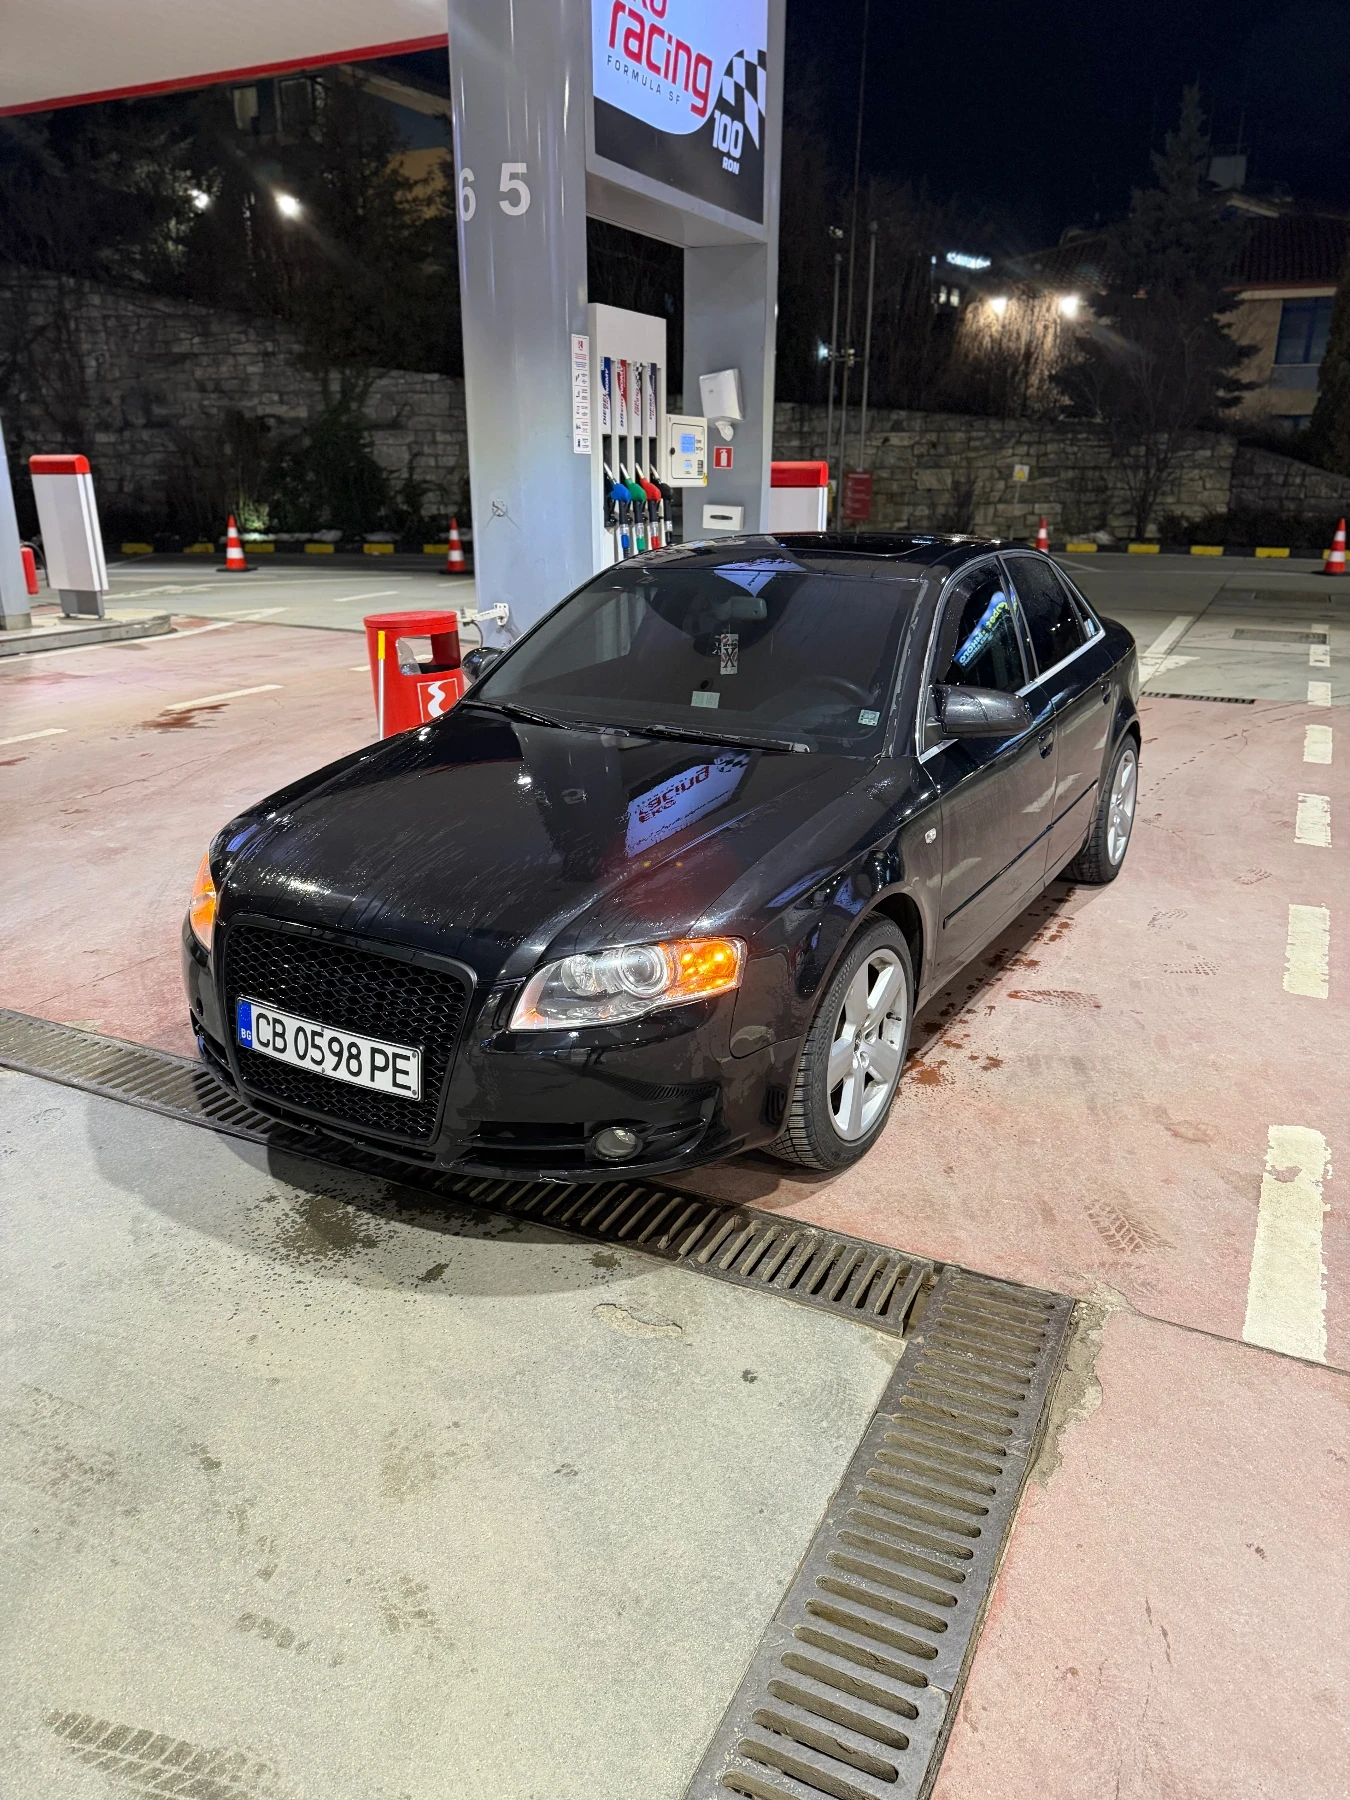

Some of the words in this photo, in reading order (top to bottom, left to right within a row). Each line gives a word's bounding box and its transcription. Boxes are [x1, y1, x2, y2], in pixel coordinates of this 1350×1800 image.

[606, 54, 662, 96] FORMULA
[668, 91, 682, 105] SF
[608, 0, 713, 119] racing
[712, 109, 744, 159] 100
[722, 156, 739, 175] RON
[458, 168, 477, 222] 6
[499, 162, 531, 216] 5
[240, 1028, 252, 1041] BG
[255, 1013, 288, 1054] CB
[294, 1025, 363, 1077] 0598
[369, 1046, 412, 1091] PE
